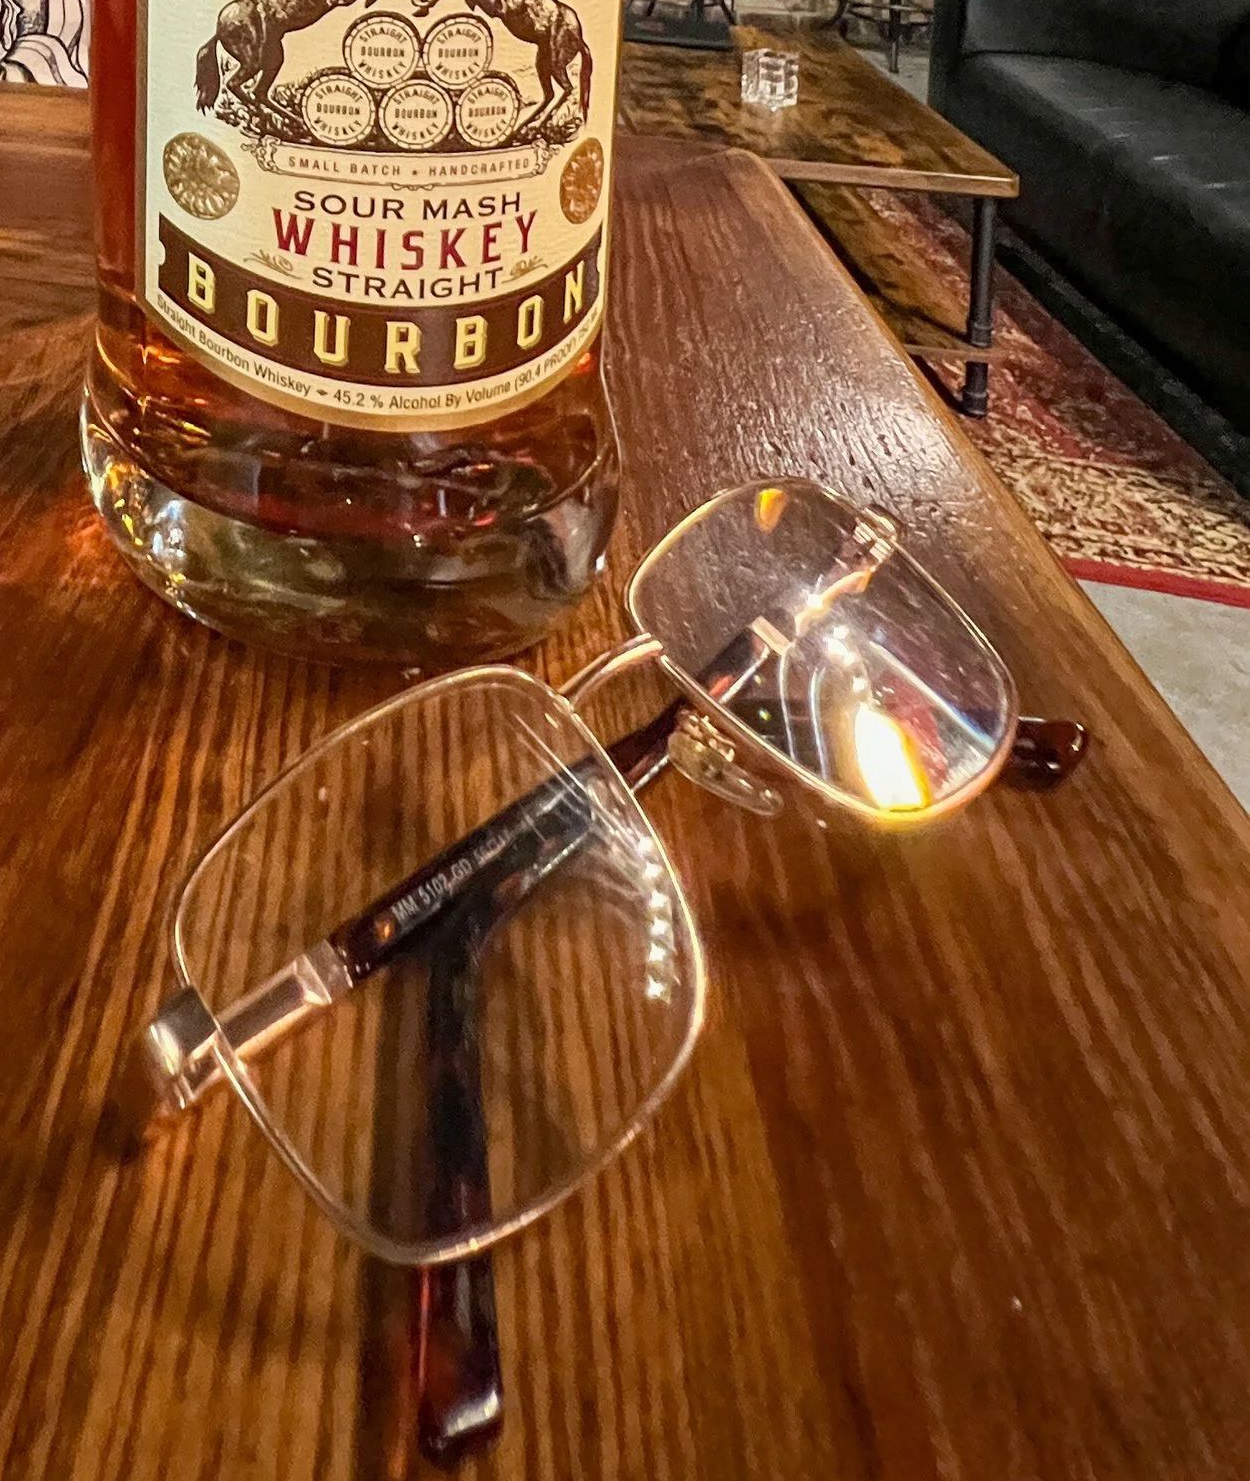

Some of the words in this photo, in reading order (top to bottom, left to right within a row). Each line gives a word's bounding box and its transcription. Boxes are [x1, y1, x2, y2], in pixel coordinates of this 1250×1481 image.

[358, 26, 407, 44] STRAIGHT
[436, 28, 482, 44] STRAIGHT
[361, 46, 405, 57] BOURBON
[438, 48, 479, 58] BOURBON
[358, 60, 407, 79] WHISKEY
[435, 62, 481, 80] WHISKEY
[315, 85, 363, 102] STRAIGHT
[393, 88, 440, 105] STRAIGHT
[467, 87, 508, 104] STRAIGHT
[316, 103, 360, 115] BOURBON
[394, 108, 438, 119] BOURBON
[468, 107, 507, 117] BOURBON
[314, 118, 362, 136] WHISKEY
[391, 122, 439, 140] WHISKEY
[466, 119, 508, 138] WHISKEY
[288, 156, 340, 173] SMALL
[350, 163, 401, 176] BATCH
[428, 157, 530, 176] HANDCRAFTED
[294, 190, 405, 220] SOUR
[422, 191, 521, 220] MASH
[271, 206, 539, 270] WHISKEY
[312, 266, 504, 300] STRAIGHT
[186, 251, 585, 375] BOURBON
[156, 294, 197, 337] Straight
[199, 330, 250, 371] Bourbon
[253, 360, 311, 397] Whiskey
[333, 389, 365, 407] 45.2
[370, 396, 384, 409] %
[388, 395, 441, 410] Alcohol
[445, 394, 462, 409] By
[466, 383, 511, 405] Volume
